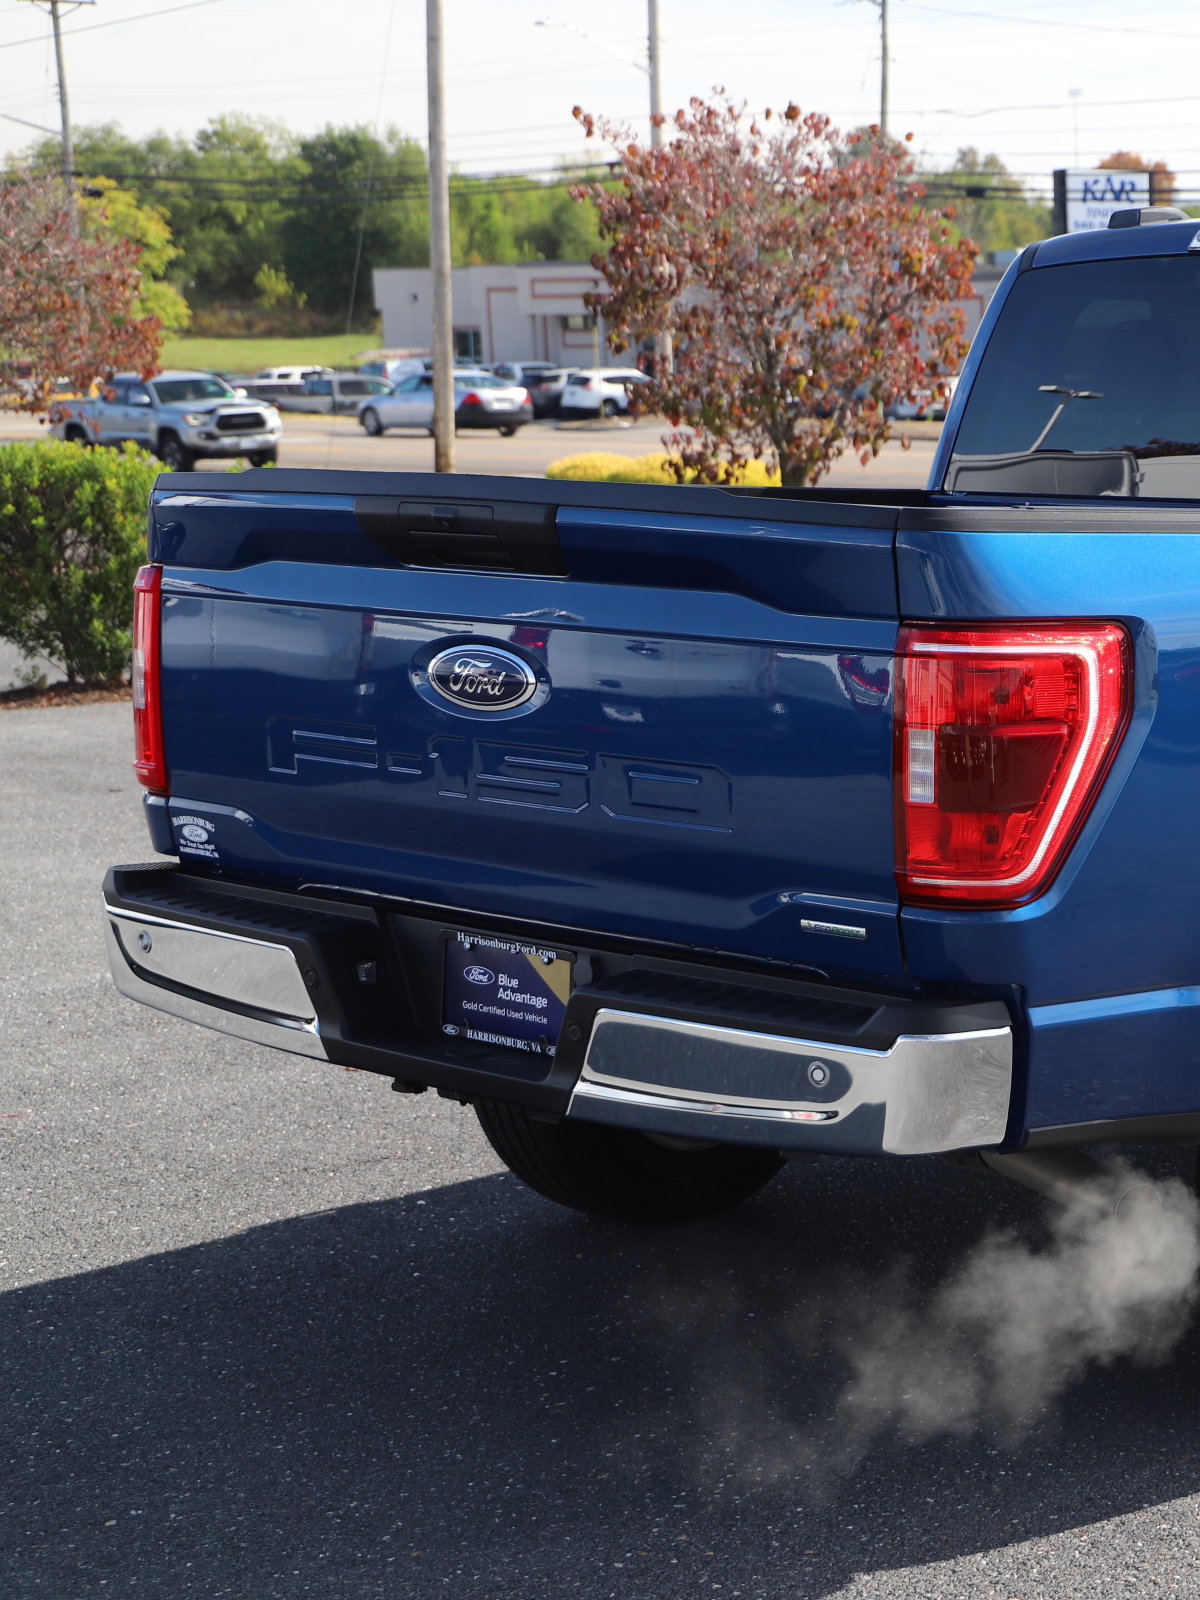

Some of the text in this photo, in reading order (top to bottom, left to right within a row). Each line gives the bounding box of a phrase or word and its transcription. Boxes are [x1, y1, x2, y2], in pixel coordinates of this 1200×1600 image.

[450, 658, 506, 695] Ford
[267, 715, 732, 833] F-150
[457, 931, 557, 959] HarrisonburgFord.com
[469, 967, 489, 982] Ford
[498, 973, 519, 988] Blue
[498, 988, 548, 1008] Advantage
[462, 1000, 548, 1024] Gold Certified Used Vehicle
[467, 1029, 530, 1051] HARRISONBURG,
[531, 1042, 541, 1053] VA
